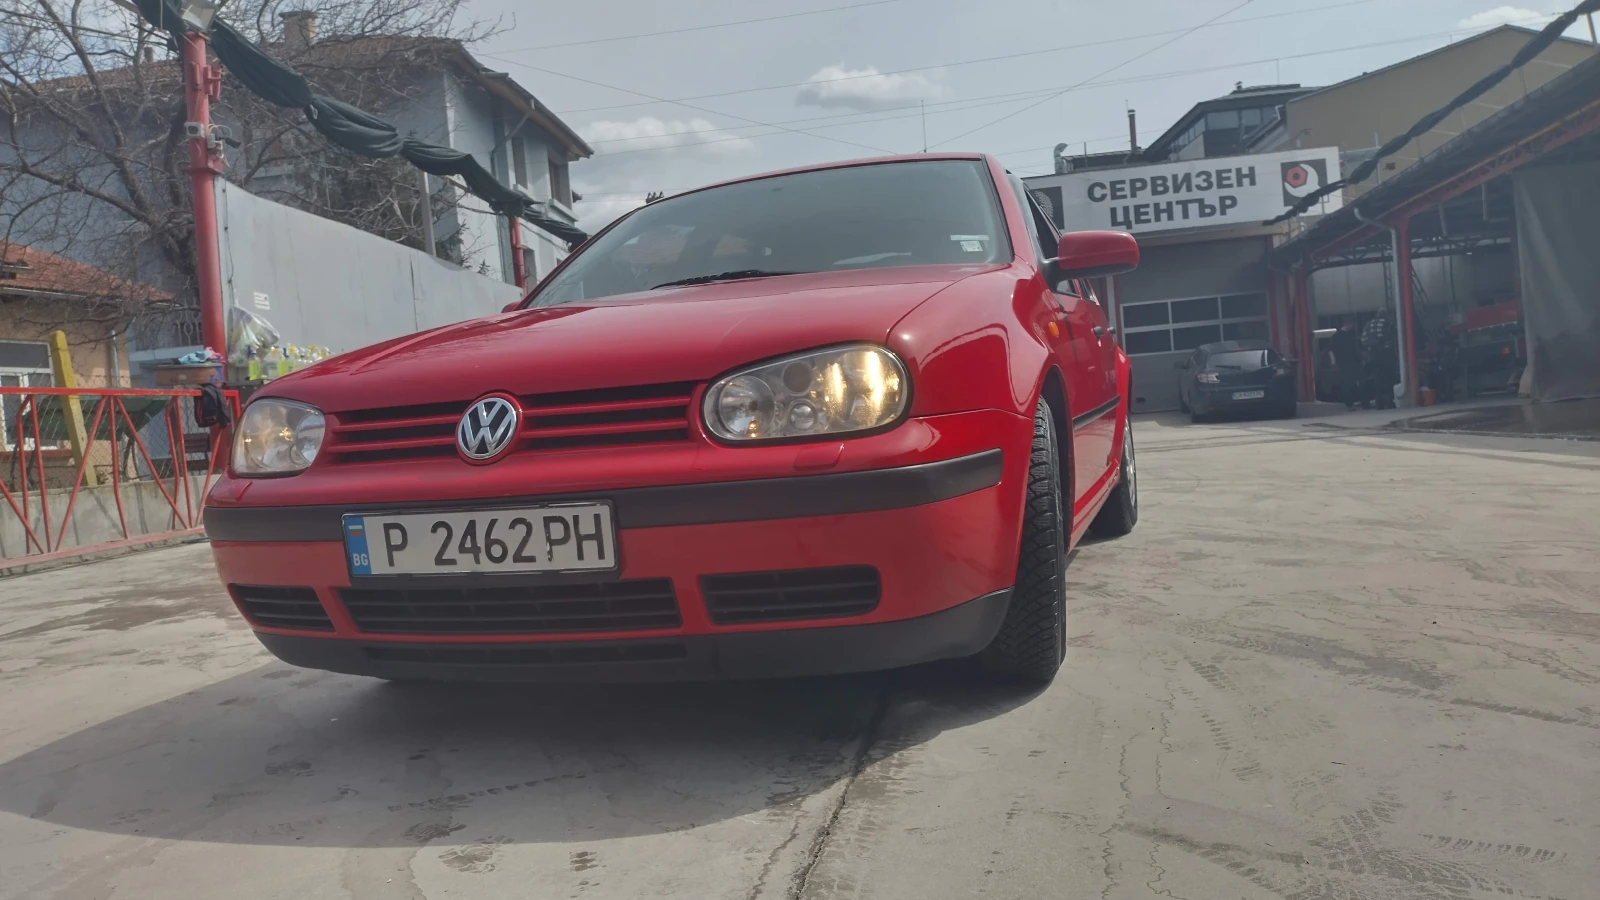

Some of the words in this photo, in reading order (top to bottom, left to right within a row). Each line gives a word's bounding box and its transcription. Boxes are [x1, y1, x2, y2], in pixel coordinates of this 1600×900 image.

[1087, 166, 1257, 203] СЕРВИЗЕН
[1110, 195, 1238, 229] ЦЕНТЪР
[458, 398, 517, 459] VW
[353, 554, 369, 566] BG
